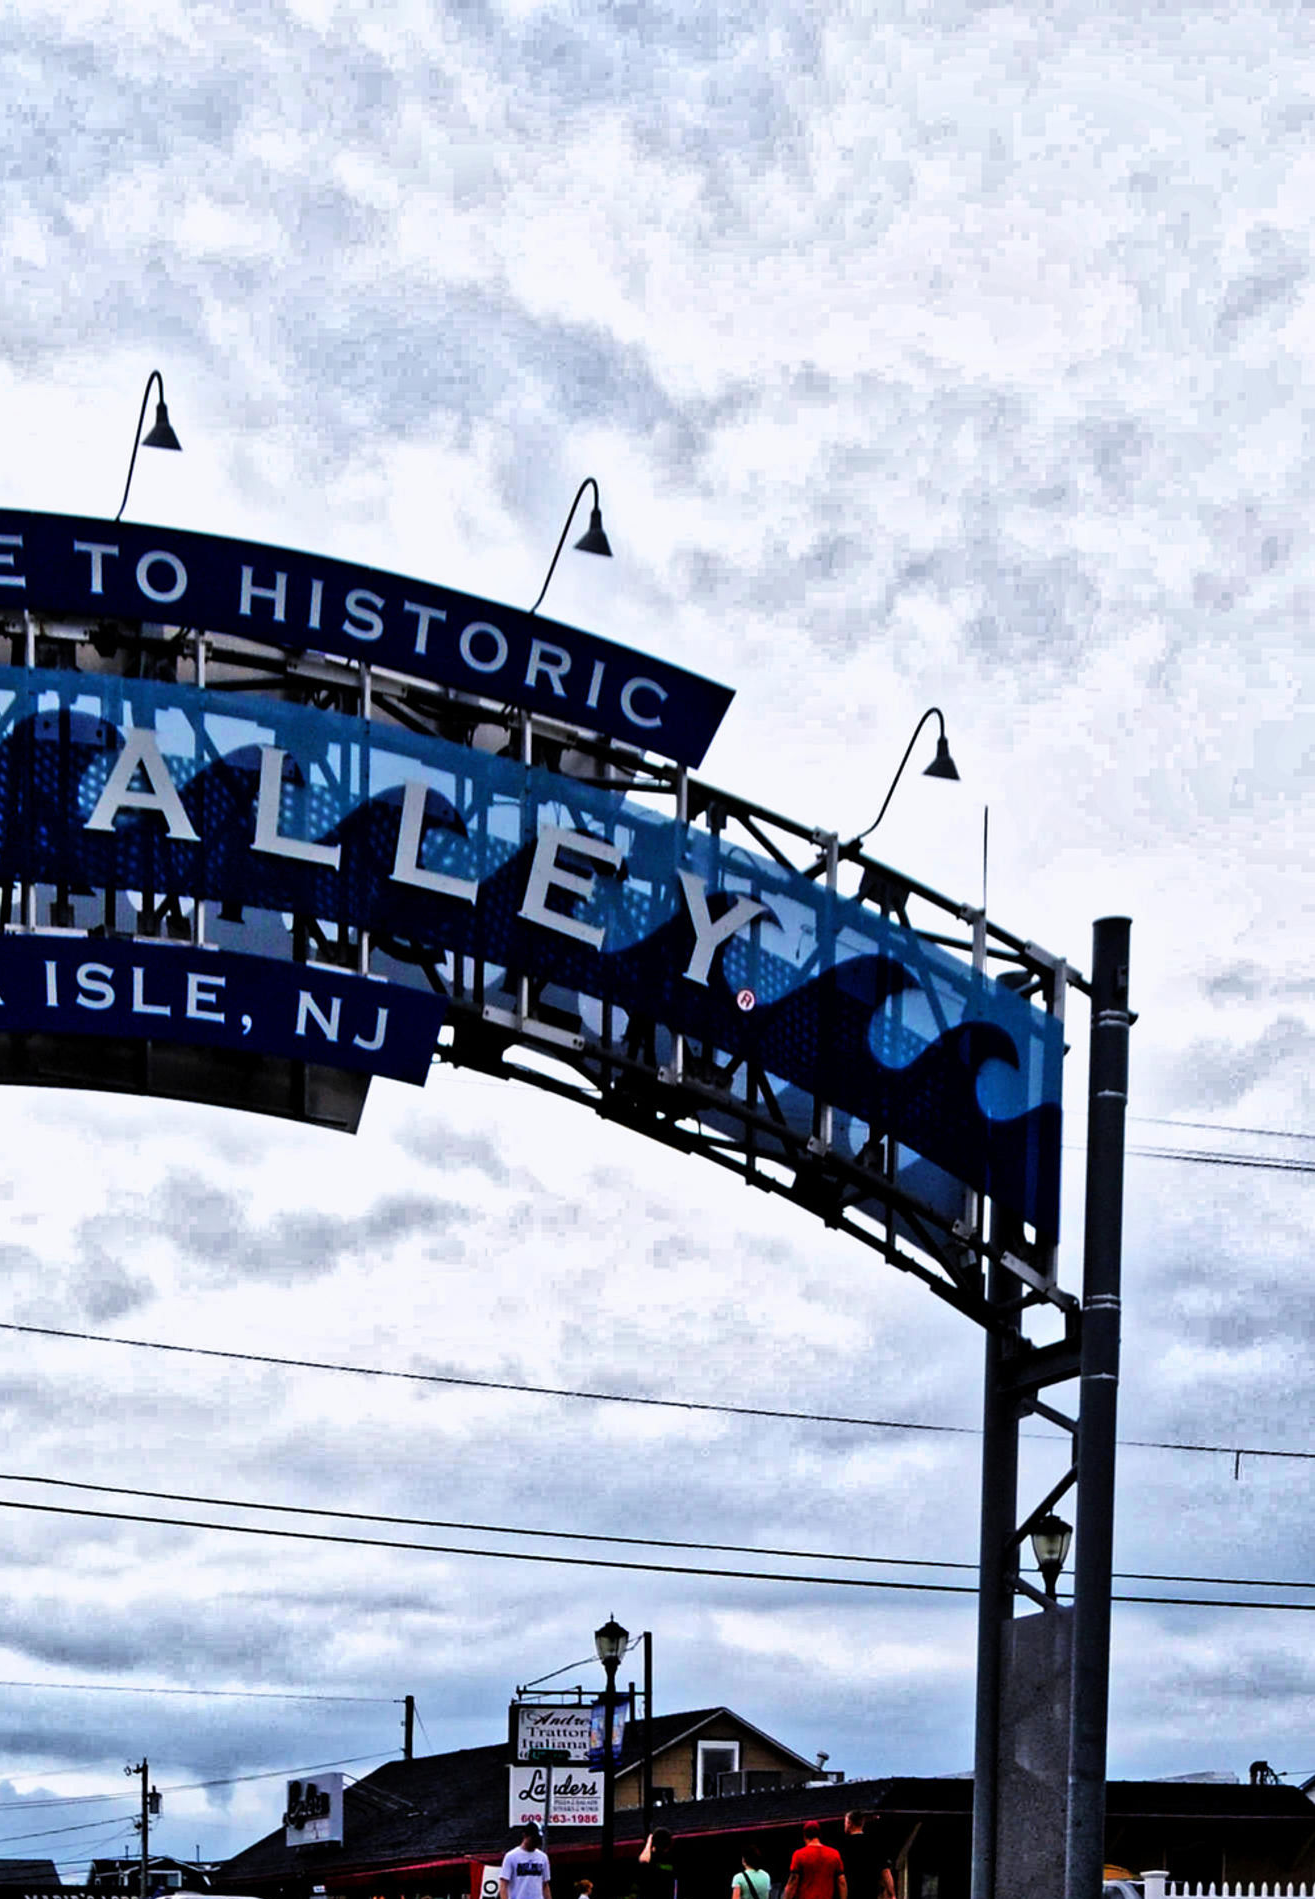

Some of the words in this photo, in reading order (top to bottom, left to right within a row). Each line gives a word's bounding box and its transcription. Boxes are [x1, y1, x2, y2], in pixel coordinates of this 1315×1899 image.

[74, 540, 188, 603] TO
[239, 565, 668, 730] HISTORIC
[83, 728, 766, 986] ALLEY
[45, 960, 253, 1035] ISLE,
[295, 990, 389, 1052] NJ
